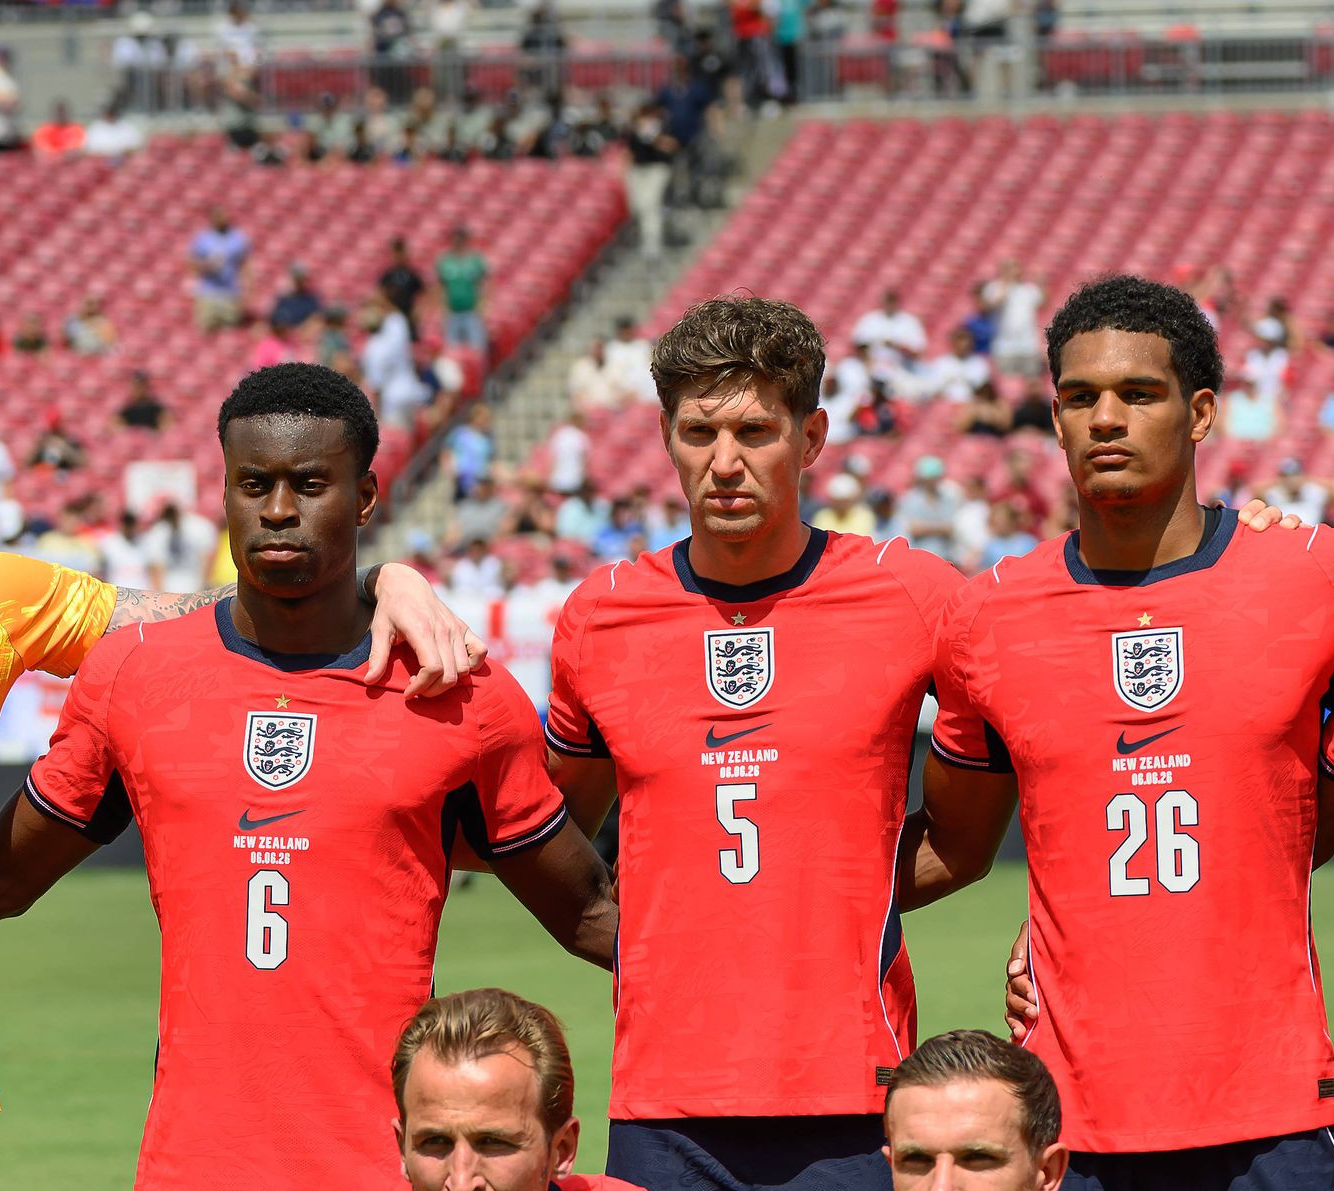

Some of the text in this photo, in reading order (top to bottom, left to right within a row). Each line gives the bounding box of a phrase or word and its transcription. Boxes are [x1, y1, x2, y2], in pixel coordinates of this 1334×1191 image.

[700, 748, 778, 766] NEW ZEALAND
[1112, 754, 1191, 772] NEW ZEALAND
[719, 764, 760, 779] 06.06.26
[1131, 771, 1173, 786] 06.06.26
[715, 782, 760, 884] 5
[233, 835, 310, 851] NEW ZEALAND
[1105, 789, 1201, 897] 26
[250, 851, 291, 865] 06.06.26
[245, 869, 289, 970] 6
